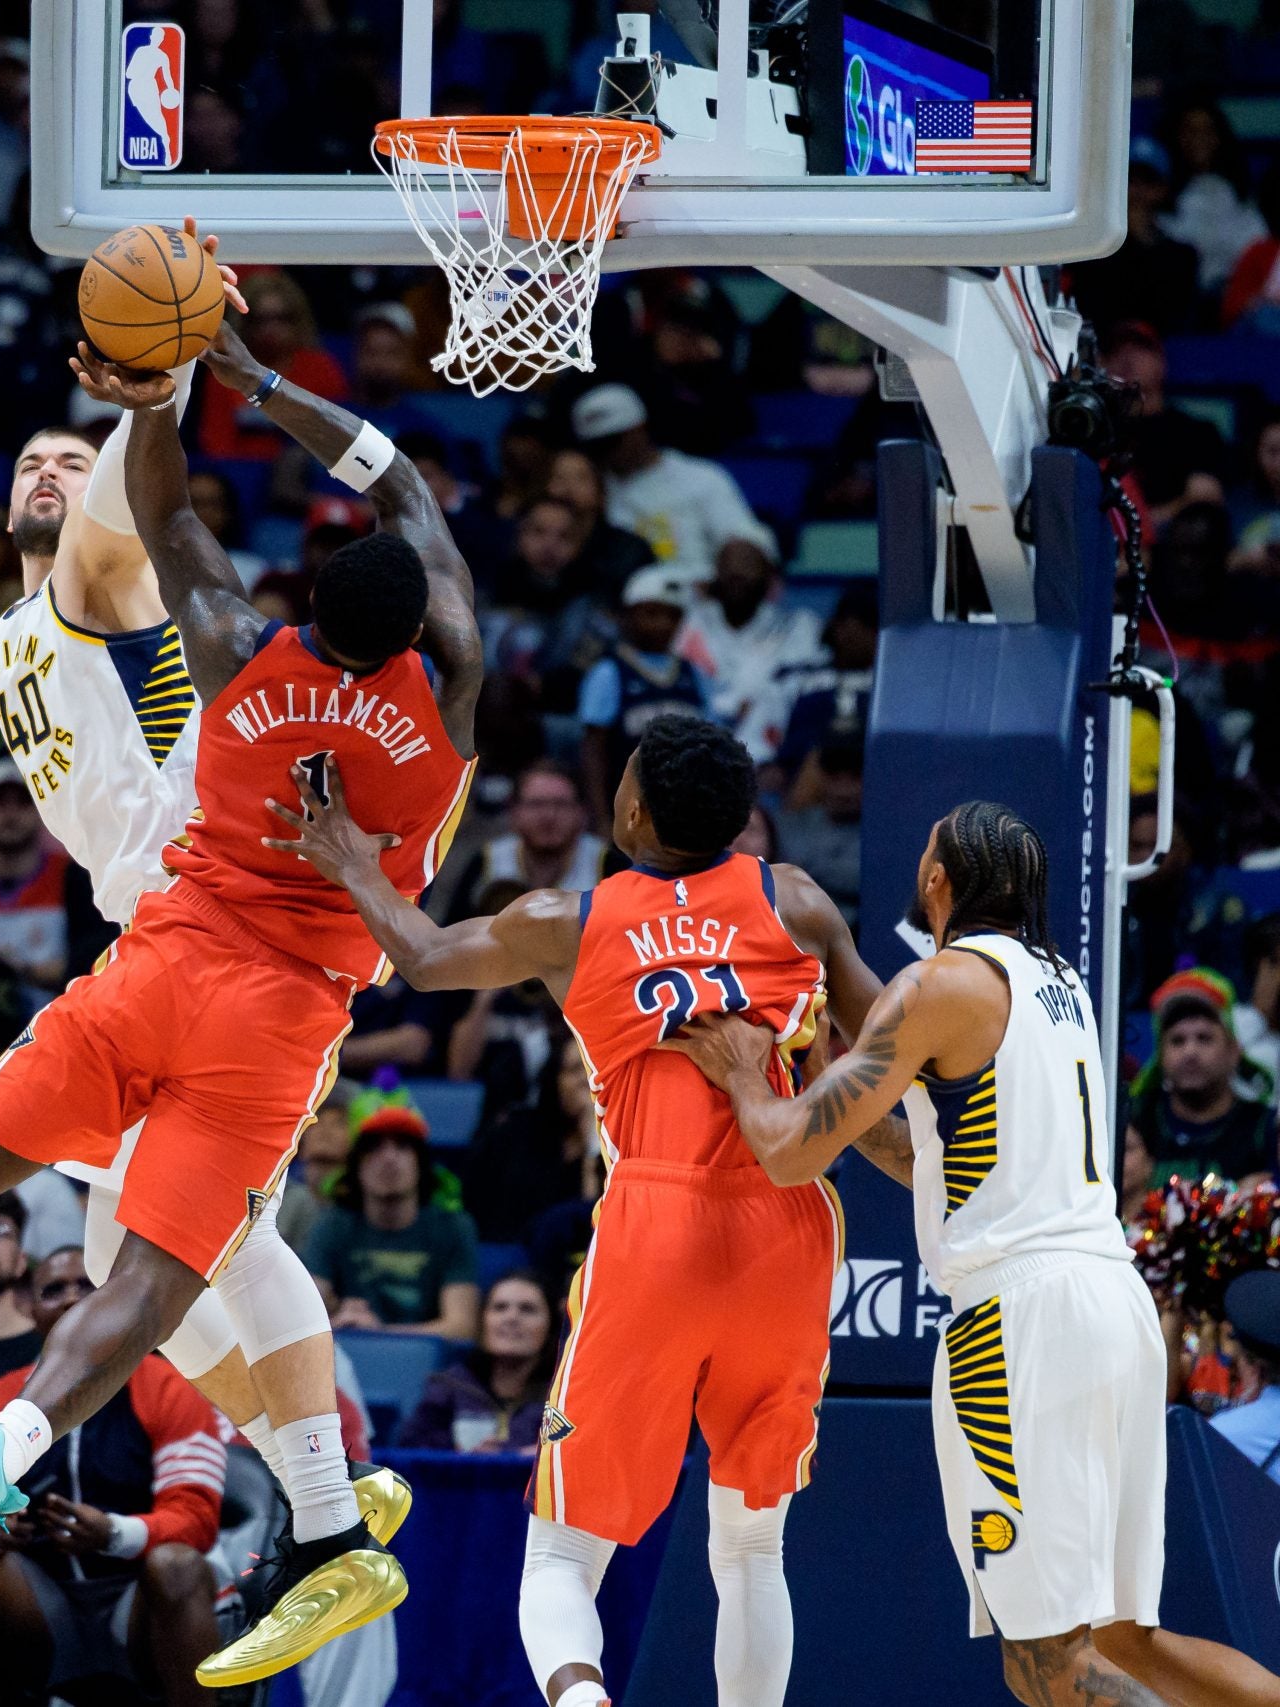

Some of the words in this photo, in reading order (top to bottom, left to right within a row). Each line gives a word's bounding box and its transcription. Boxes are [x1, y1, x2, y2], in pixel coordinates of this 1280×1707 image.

[130, 137, 159, 160] NBA
[225, 684, 431, 766] WILLIAMSON
[32, 727, 73, 800] CERS
[1079, 716, 1096, 990] DUCTS.COM
[625, 916, 738, 966] MISSI
[634, 964, 750, 1043] 21
[1035, 984, 1085, 1031] TOPPIN
[1076, 1059, 1102, 1184] 1
